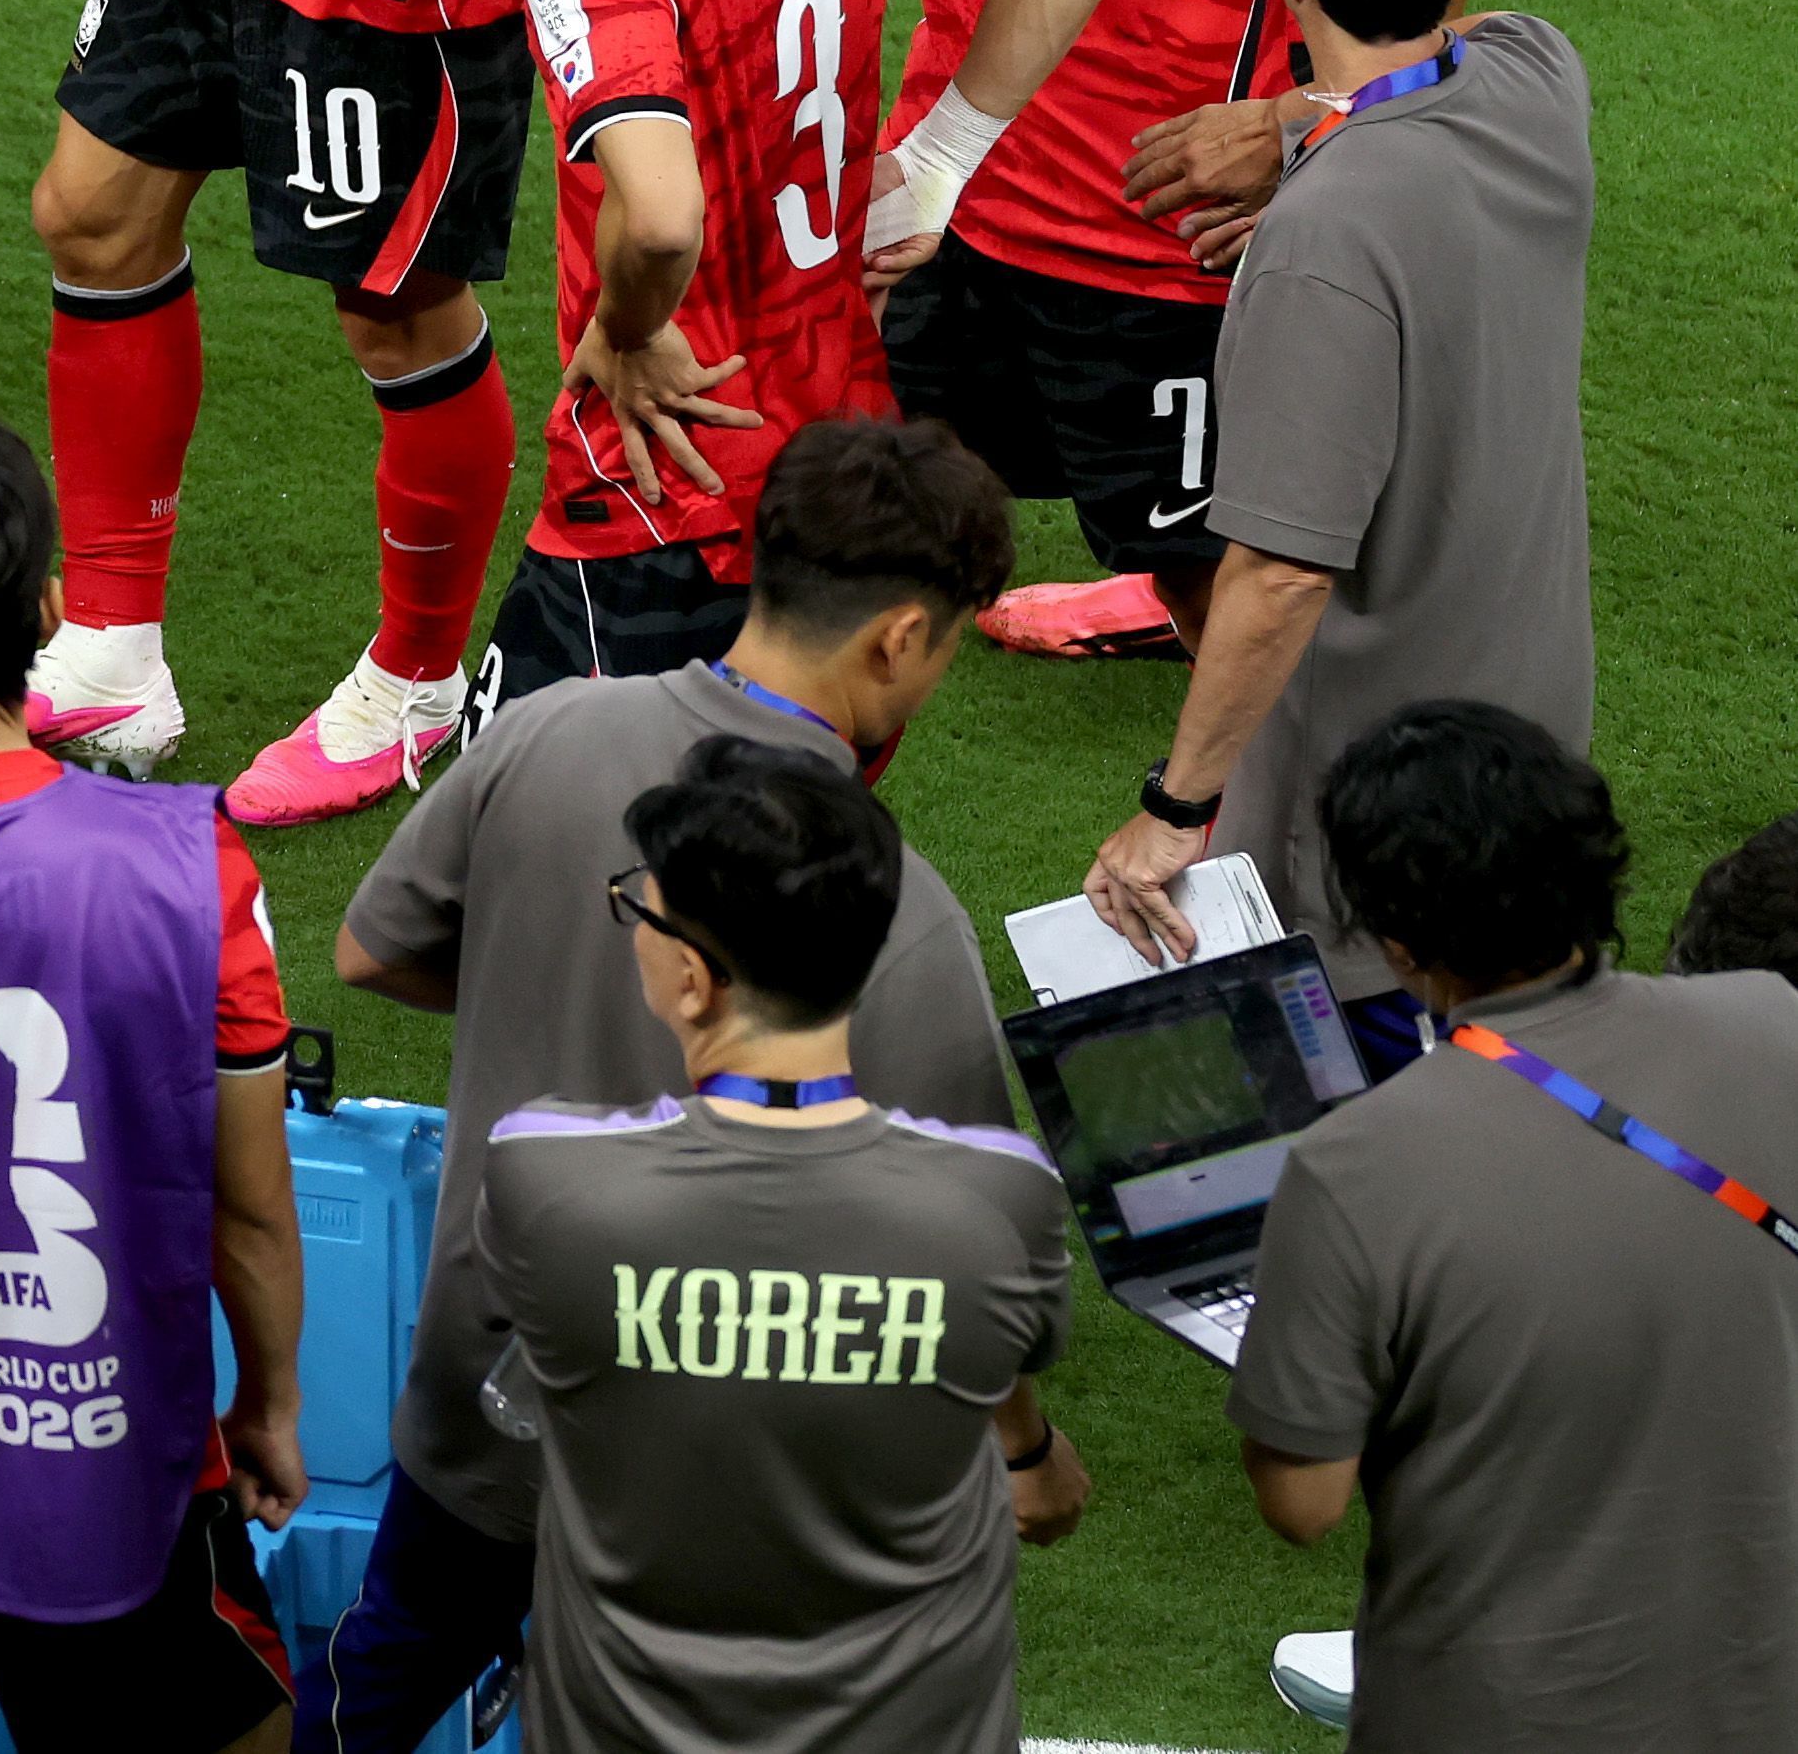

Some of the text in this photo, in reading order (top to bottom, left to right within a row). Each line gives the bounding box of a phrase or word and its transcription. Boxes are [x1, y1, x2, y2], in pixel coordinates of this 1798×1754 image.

[285, 67, 382, 204] 10
[1152, 377, 1207, 490] 7
[47, 1355, 120, 1395] CUP
[612, 1263, 946, 1385] KOREA
